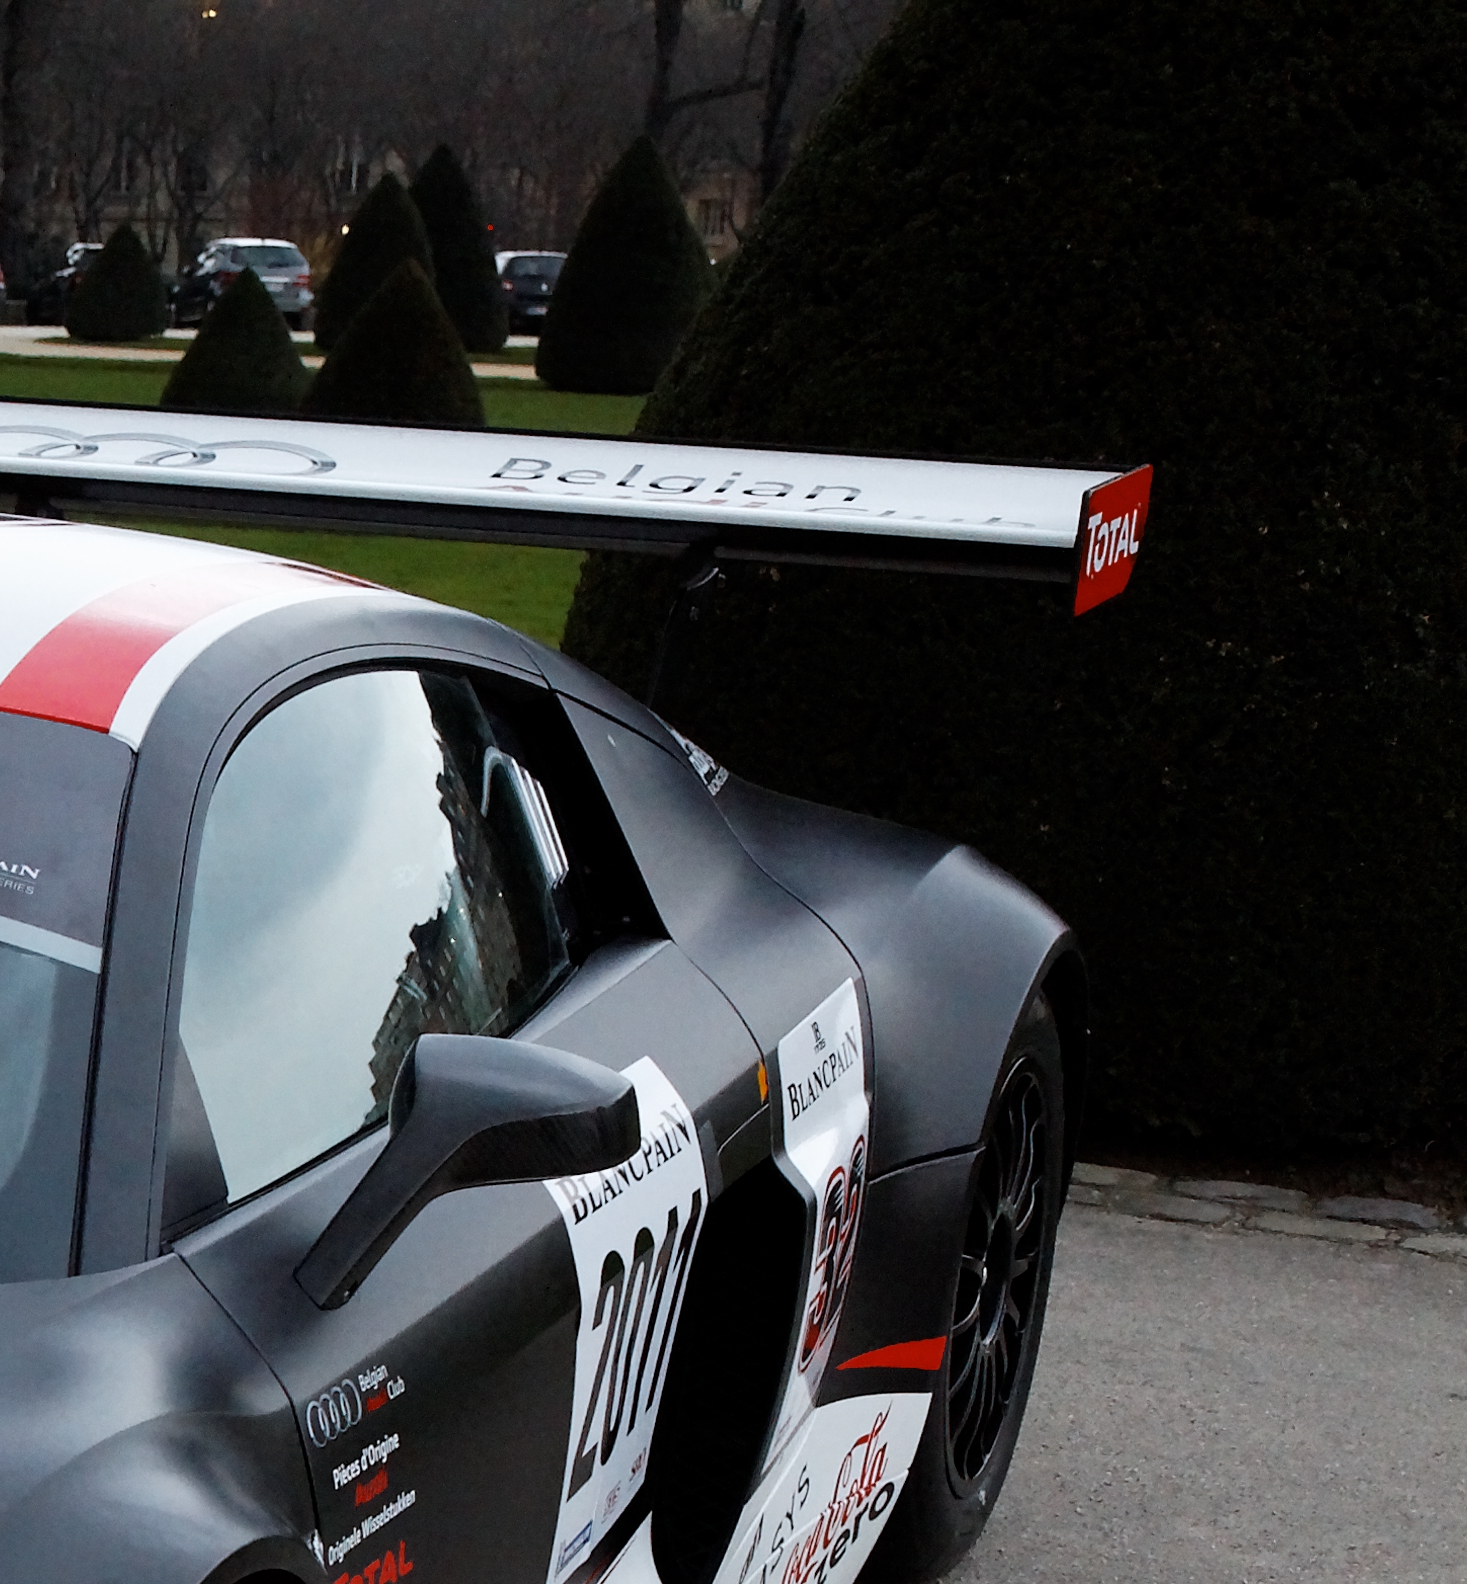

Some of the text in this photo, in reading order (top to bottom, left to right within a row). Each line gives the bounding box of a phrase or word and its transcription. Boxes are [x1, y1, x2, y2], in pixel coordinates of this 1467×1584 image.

[489, 457, 862, 503] Belgian
[1085, 508, 1140, 578] TOTAL
[787, 1024, 860, 1121] BLANCPAIN
[555, 1102, 693, 1226] BLANCPAIN
[565, 1186, 702, 1503] 2011
[358, 1364, 389, 1392] Belgian
[387, 1375, 406, 1400] Club
[332, 1432, 401, 1490] Pièces d'Origine
[328, 1526, 362, 1567] Originele
